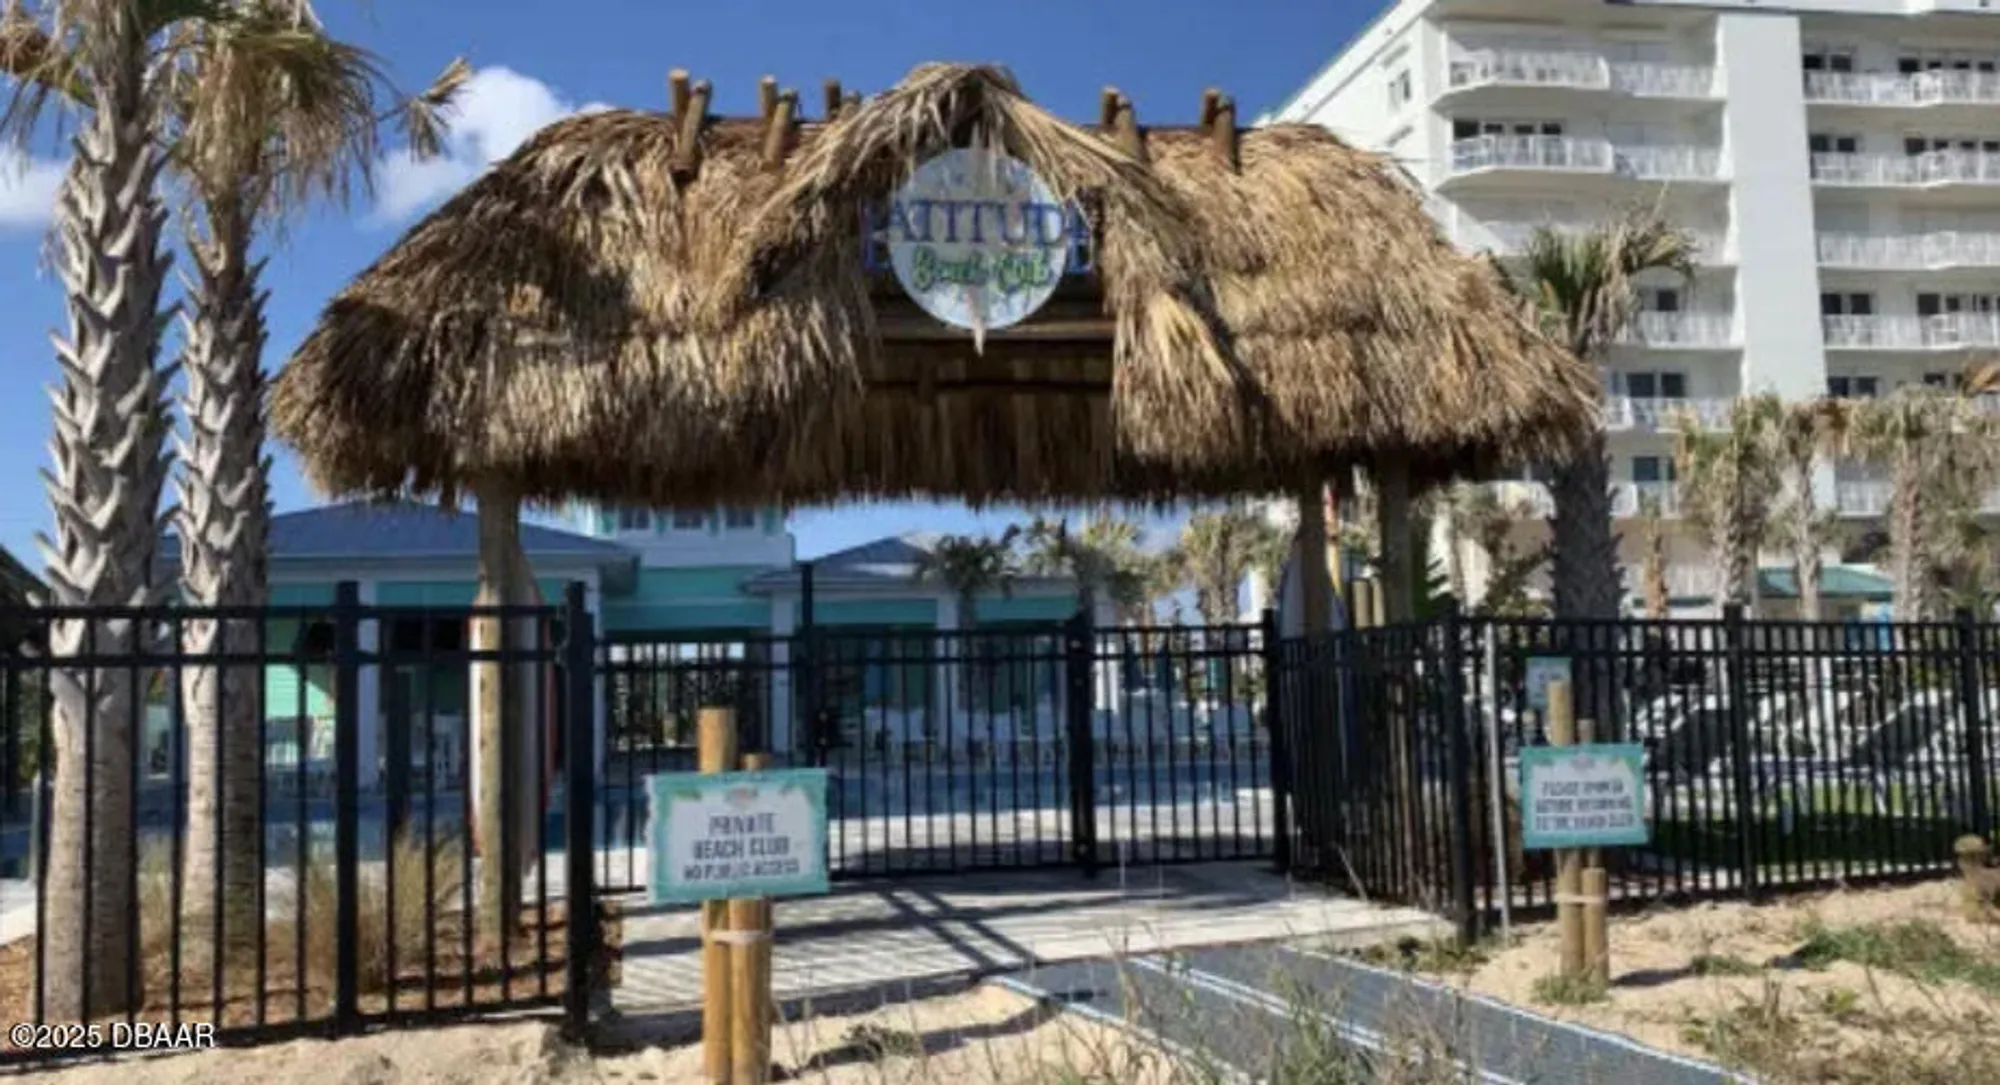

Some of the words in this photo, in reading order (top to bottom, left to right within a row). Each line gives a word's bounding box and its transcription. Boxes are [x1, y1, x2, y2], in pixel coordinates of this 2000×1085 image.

[708, 813, 775, 836] PRIVATE
[692, 839, 745, 861] BEACH
[750, 836, 790, 857] CLUB
